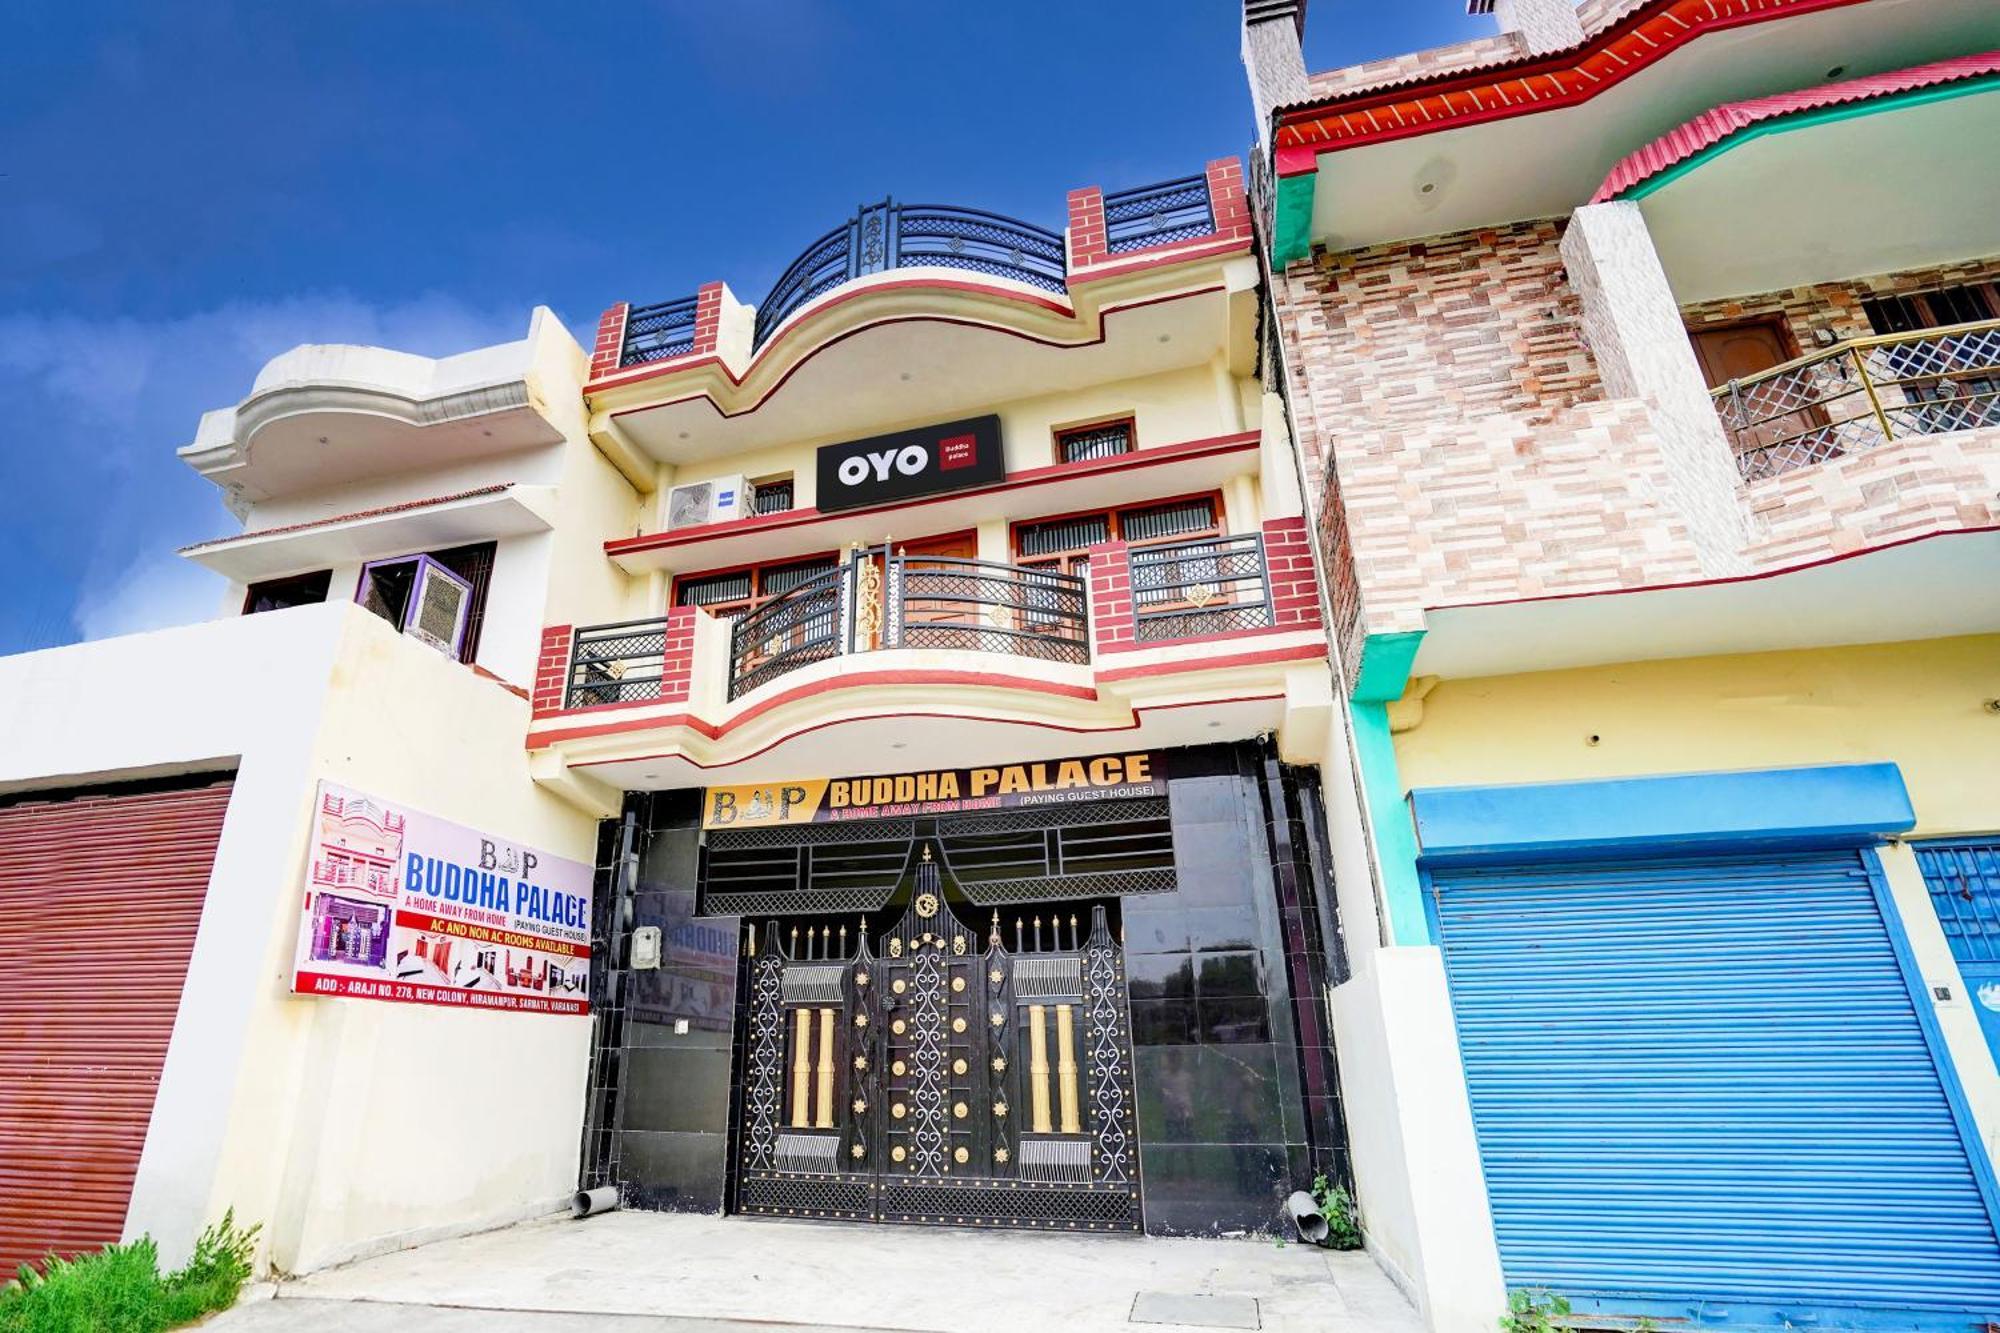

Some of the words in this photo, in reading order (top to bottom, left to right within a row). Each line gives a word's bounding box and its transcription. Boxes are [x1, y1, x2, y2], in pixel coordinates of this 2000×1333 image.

[945, 442, 969, 452] Buddha
[948, 451, 969, 461] palace
[838, 444, 928, 486] OYO
[830, 772, 960, 808] BUDDHA
[970, 754, 1152, 797] PALACE
[1020, 791, 1065, 806] (PAYING
[1067, 789, 1107, 801] GUEST
[1109, 786, 1155, 798] HOUSE)
[711, 792, 737, 825] B
[780, 786, 806, 821] P
[842, 807, 878, 820] HOME
[881, 803, 920, 817] AWAY
[922, 800, 960, 814] FROM
[962, 796, 1002, 810] HOME
[478, 838, 497, 870] B
[522, 851, 538, 879] P
[405, 852, 509, 913] BUDDHA
[515, 881, 587, 929] PALACE
[405, 897, 411, 907] A
[414, 897, 437, 913] HOME
[439, 903, 463, 918] AWAY
[464, 908, 485, 923] FROM
[486, 913, 506, 927] HOME
[430, 919, 444, 932] AC
[446, 923, 467, 937] AND
[469, 926, 488, 941] NON
[490, 930, 503, 942] AC
[504, 934, 534, 948] ROOMS
[535, 939, 575, 955] AVAILABLE
[514, 919, 541, 934] (PAYING
[542, 924, 563, 937] GUEST
[563, 929, 587, 944] HOUSE)
[315, 978, 338, 991] ADD
[348, 981, 376, 996] ARAJI
[378, 983, 394, 997] NO.
[396, 986, 414, 1000] 278,
[416, 988, 435, 1000] NEW
[436, 990, 469, 1004] COLONY,
